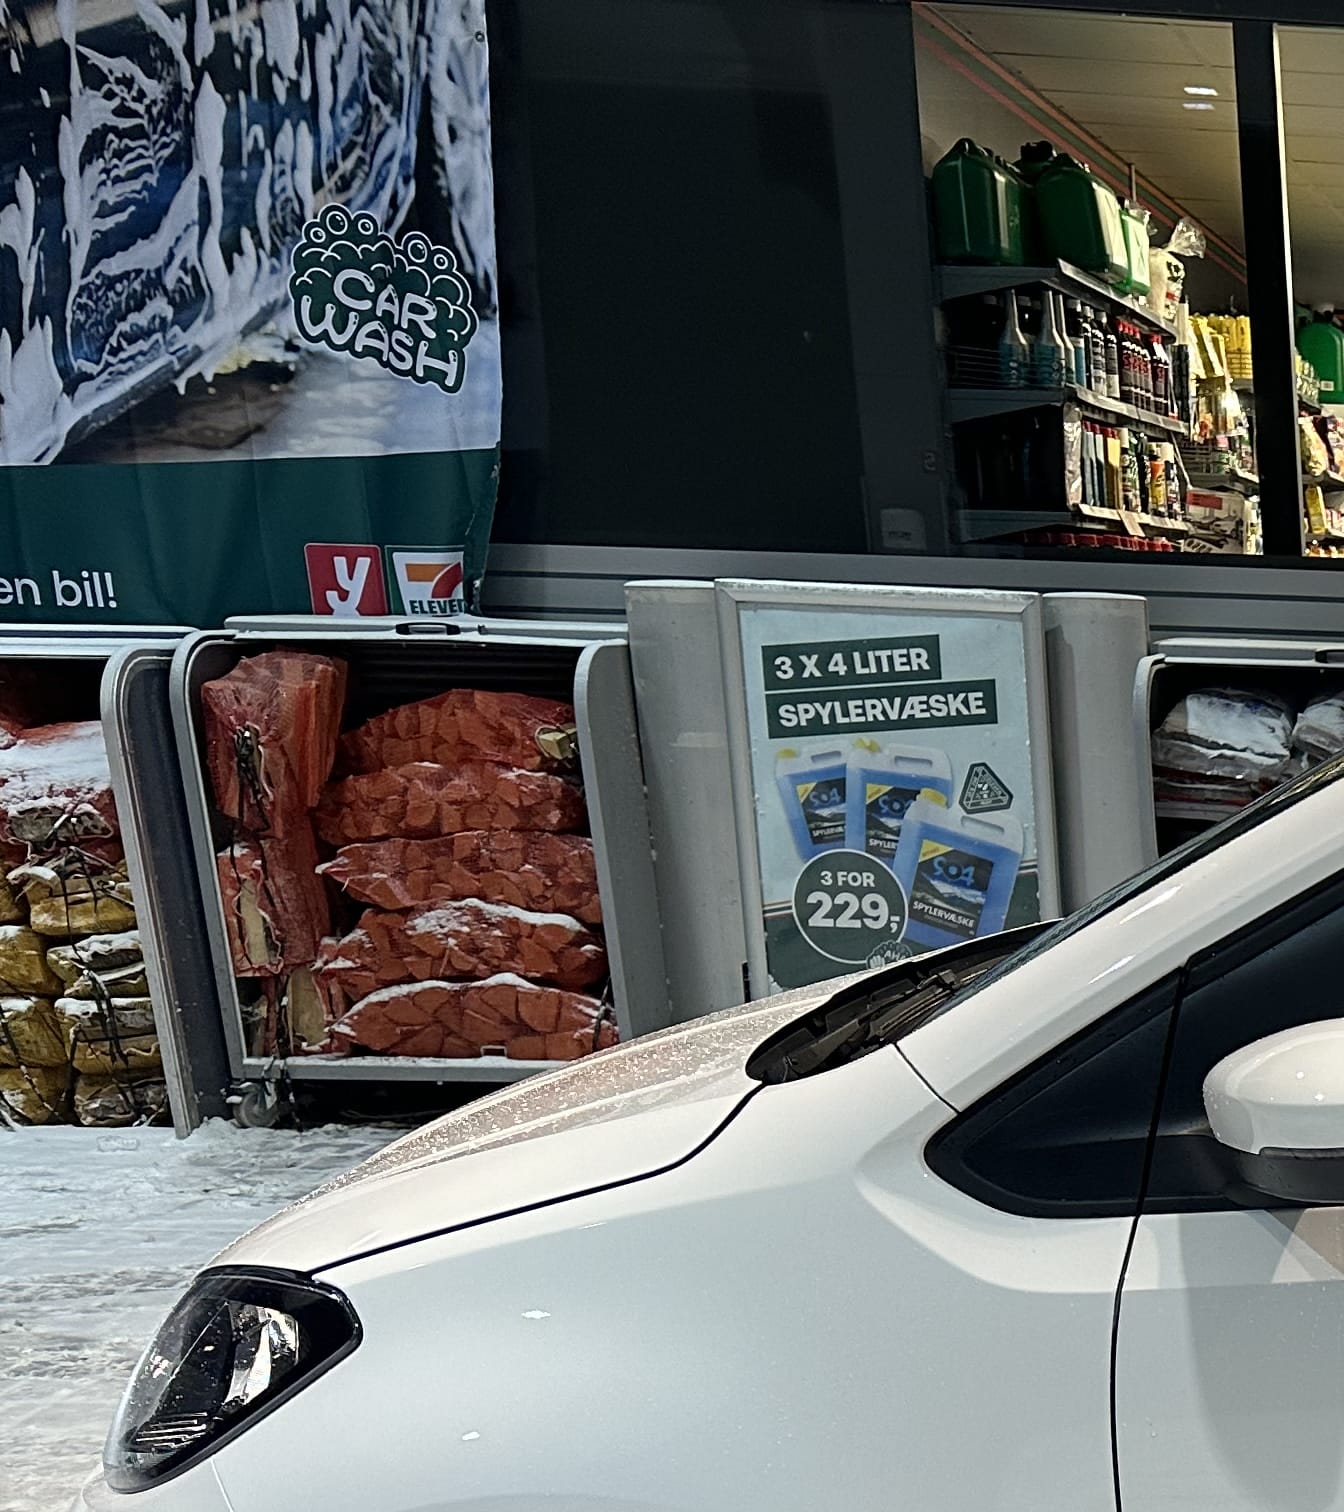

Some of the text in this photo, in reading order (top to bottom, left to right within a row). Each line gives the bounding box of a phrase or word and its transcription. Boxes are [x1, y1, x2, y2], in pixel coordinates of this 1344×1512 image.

[333, 268, 438, 339] CAR
[300, 295, 459, 387] WASH
[51, 569, 117, 608] bil!
[774, 647, 931, 680] 3 X 4 LITER
[778, 691, 987, 728] SPYLERVÆSKE
[820, 870, 876, 888] 3 FOR
[912, 900, 975, 928] SPYLERVÆSKE
